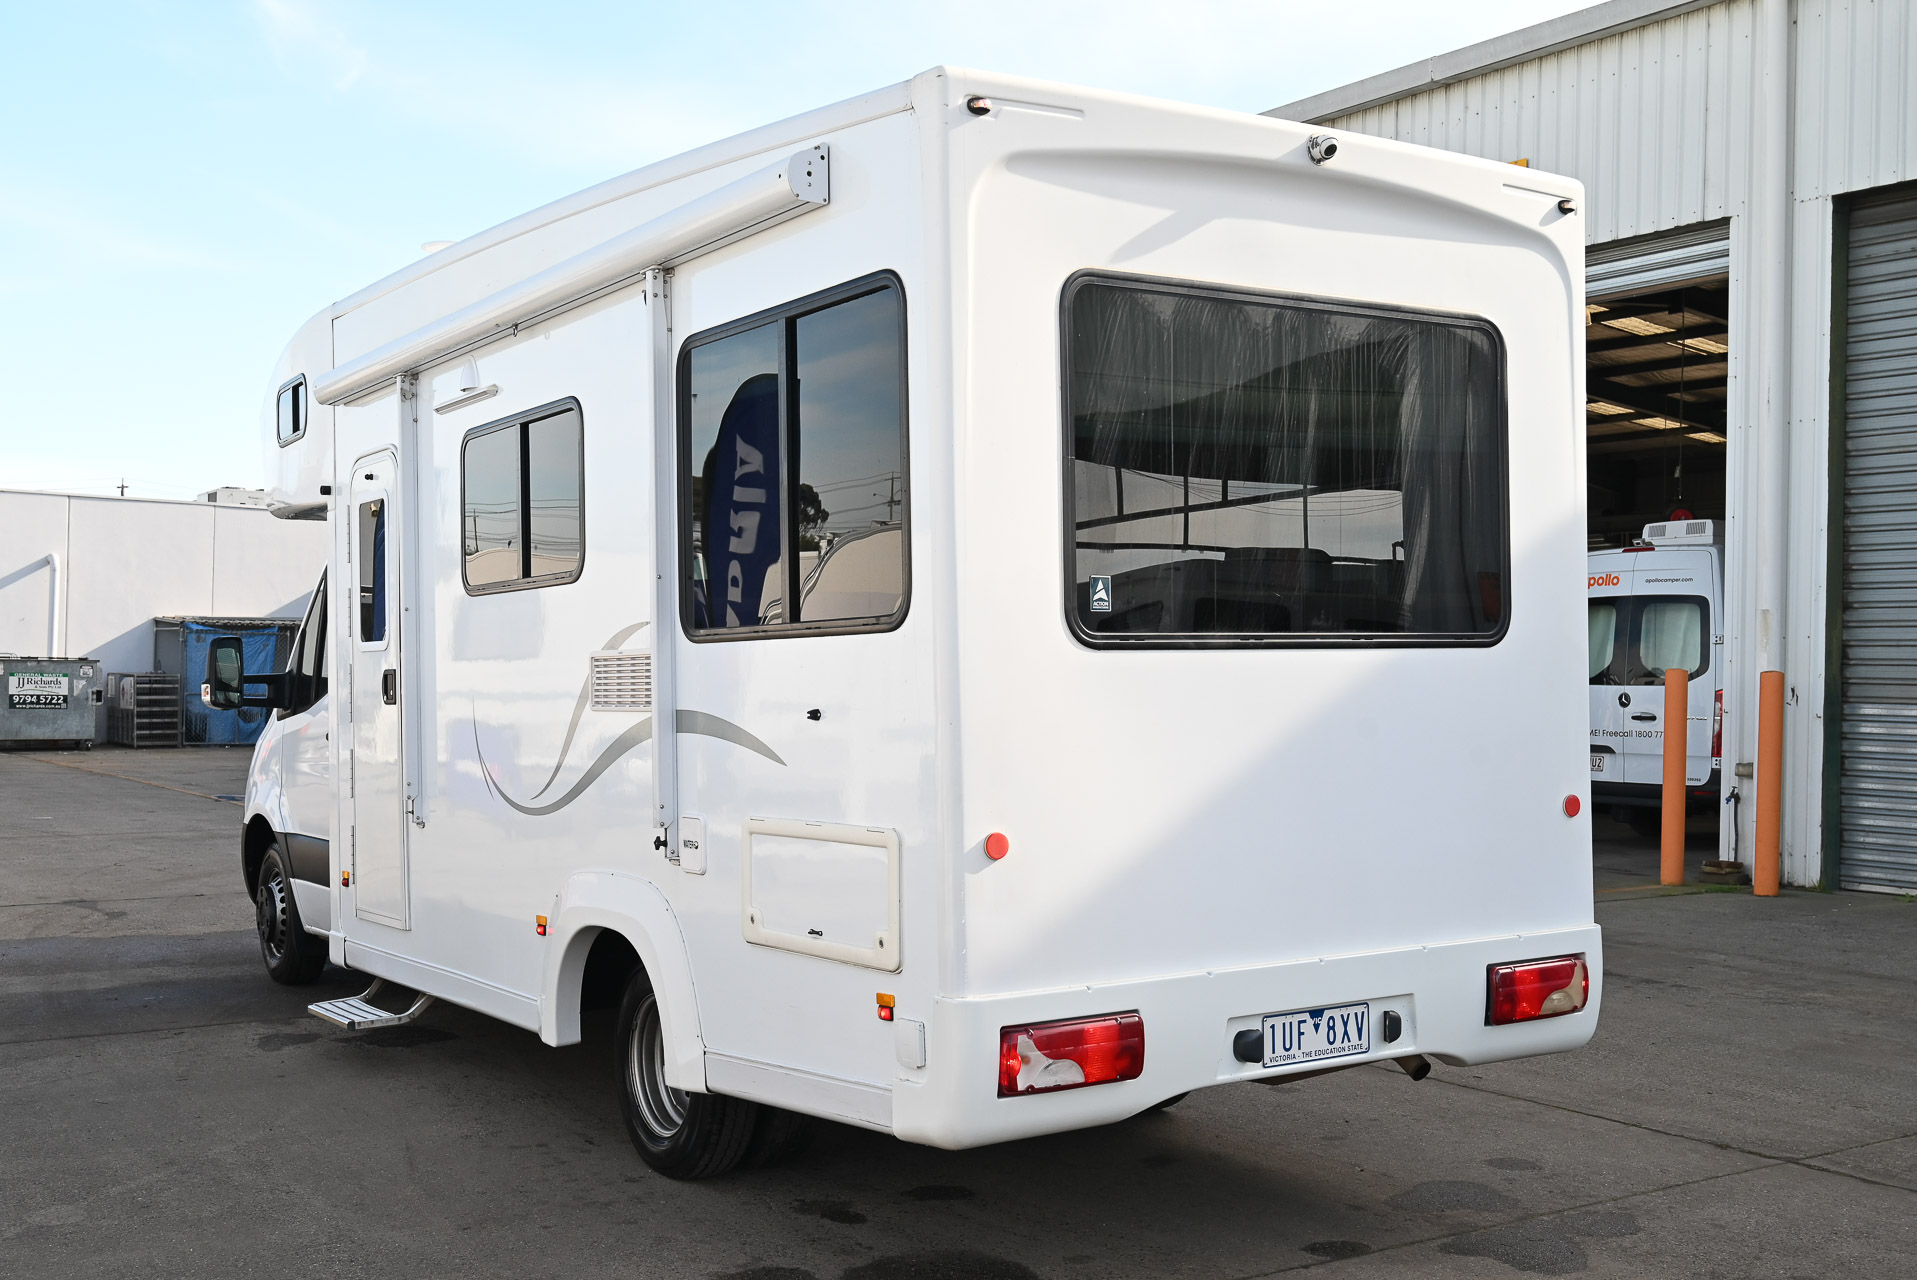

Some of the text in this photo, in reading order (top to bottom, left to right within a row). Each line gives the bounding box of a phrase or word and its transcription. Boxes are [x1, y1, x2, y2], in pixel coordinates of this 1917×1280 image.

[1588, 573, 1620, 590] pollo
[16, 677, 62, 689] JJ Richards
[13, 695, 64, 703] 9794 5722
[1602, 729, 1633, 738] Freecall
[1635, 730, 1653, 738] 1800
[1269, 1011, 1365, 1054] 1UF 8XV
[1269, 1053, 1297, 1063] VICTORIA
[1314, 1046, 1346, 1057] EDUCATION
